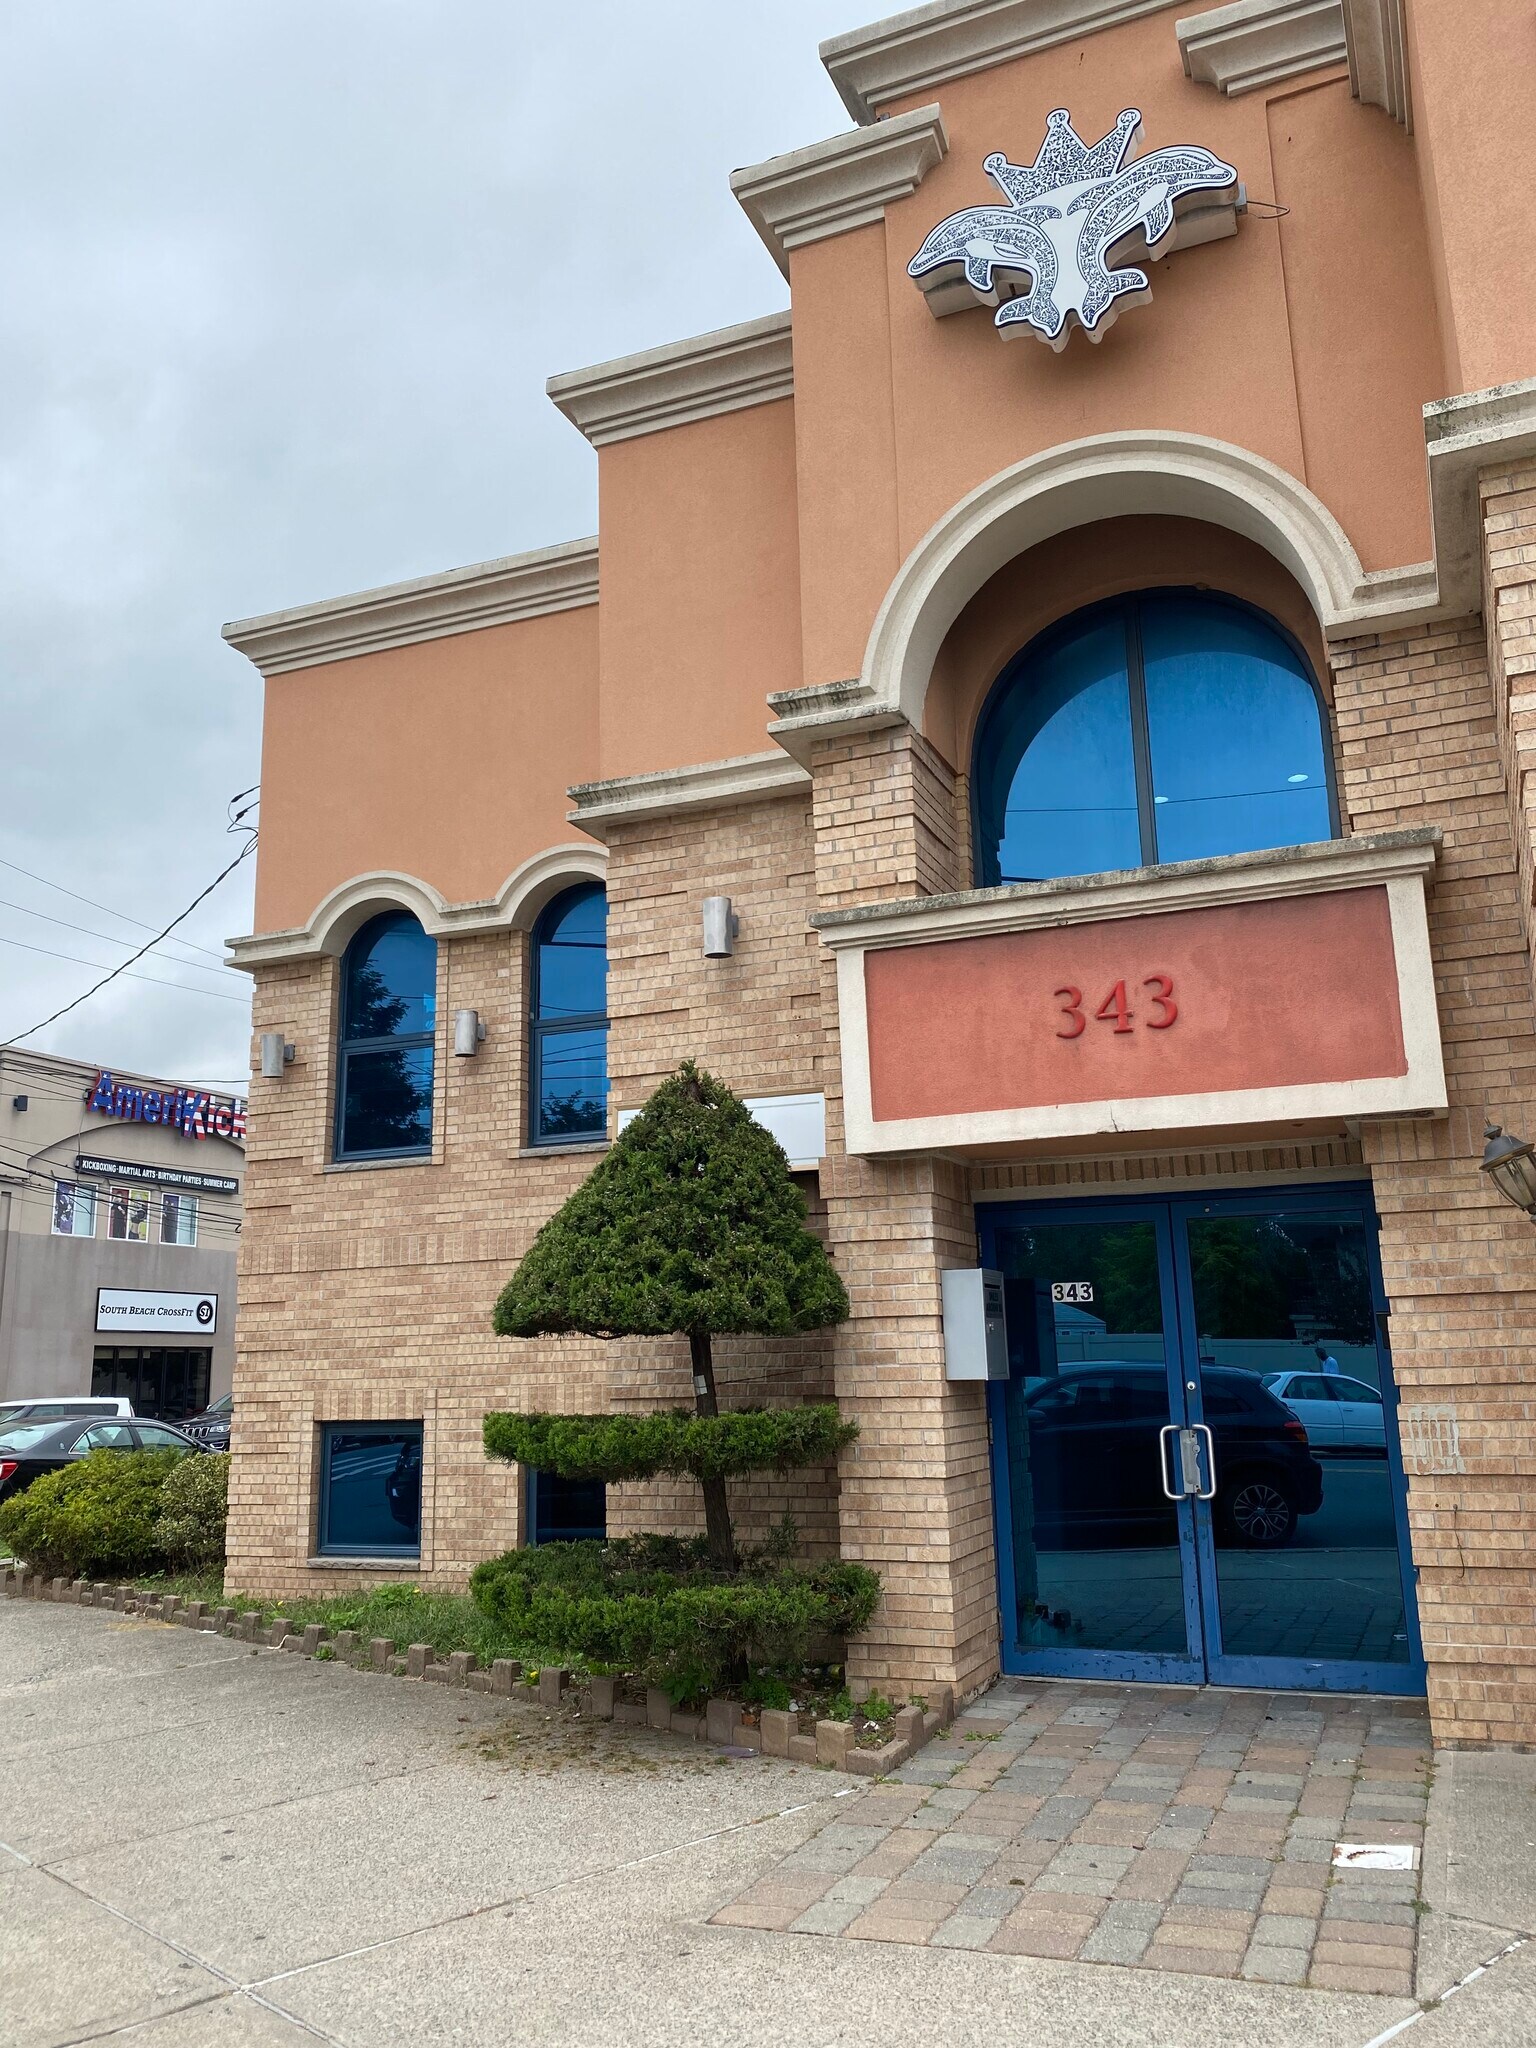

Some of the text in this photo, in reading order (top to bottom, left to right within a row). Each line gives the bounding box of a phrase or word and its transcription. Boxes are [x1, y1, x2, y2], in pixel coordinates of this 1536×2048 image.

[1054, 974, 1178, 1039] 343
[82, 1159, 237, 1190] KICKBOXING MARTIAL ARTS BIRTHDAY PARTIES SUMMER CAMP
[1053, 1284, 1092, 1301] 343
[100, 1305, 127, 1315] SOUTH
[129, 1306, 155, 1316] BEACH
